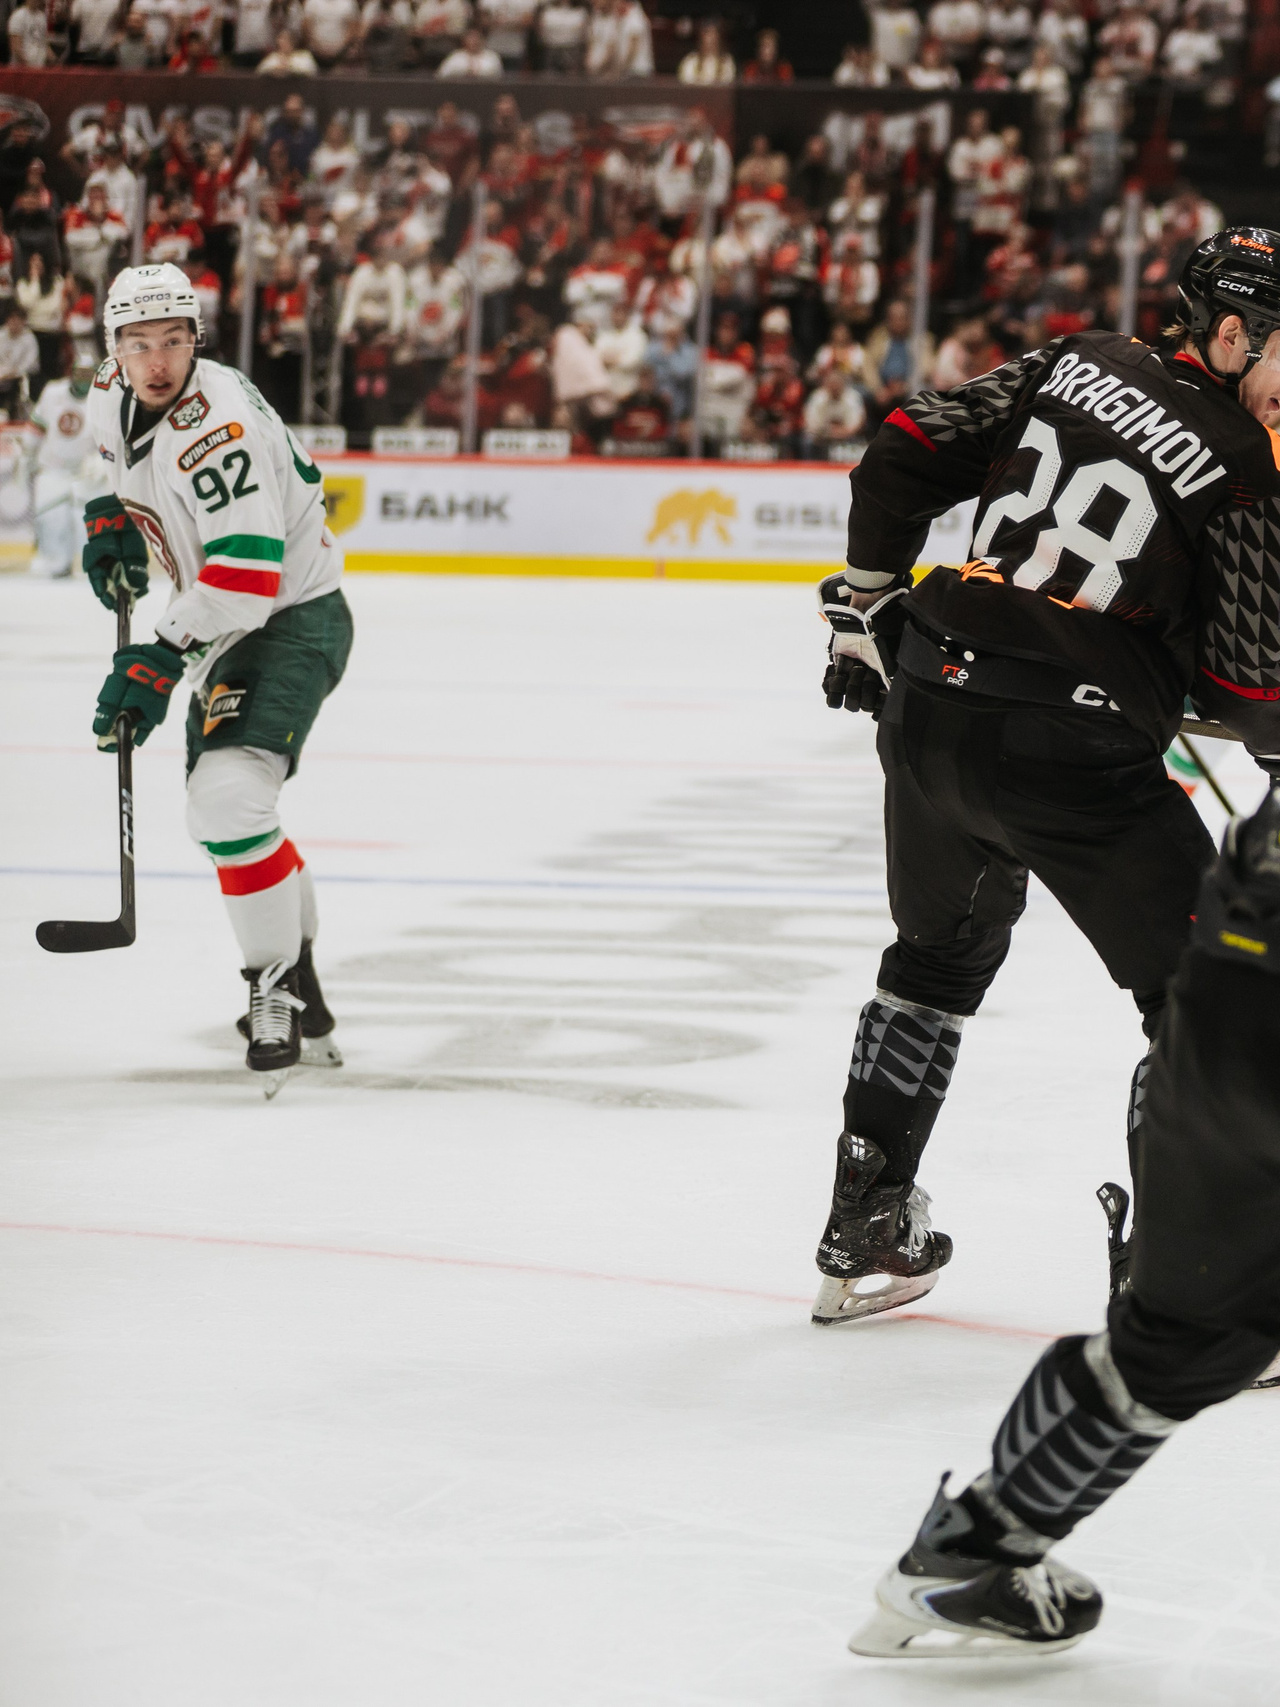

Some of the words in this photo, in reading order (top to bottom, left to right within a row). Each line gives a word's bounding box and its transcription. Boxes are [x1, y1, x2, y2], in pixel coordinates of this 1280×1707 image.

[1216, 279, 1256, 295] CCM
[1037, 352, 1228, 500] BRAGIMOV
[180, 427, 230, 470] WINLINE
[191, 448, 260, 514] 92
[379, 490, 510, 523] БАНК
[972, 415, 1159, 613] 28
[941, 664, 969, 680] FT6
[946, 676, 964, 687] PRO
